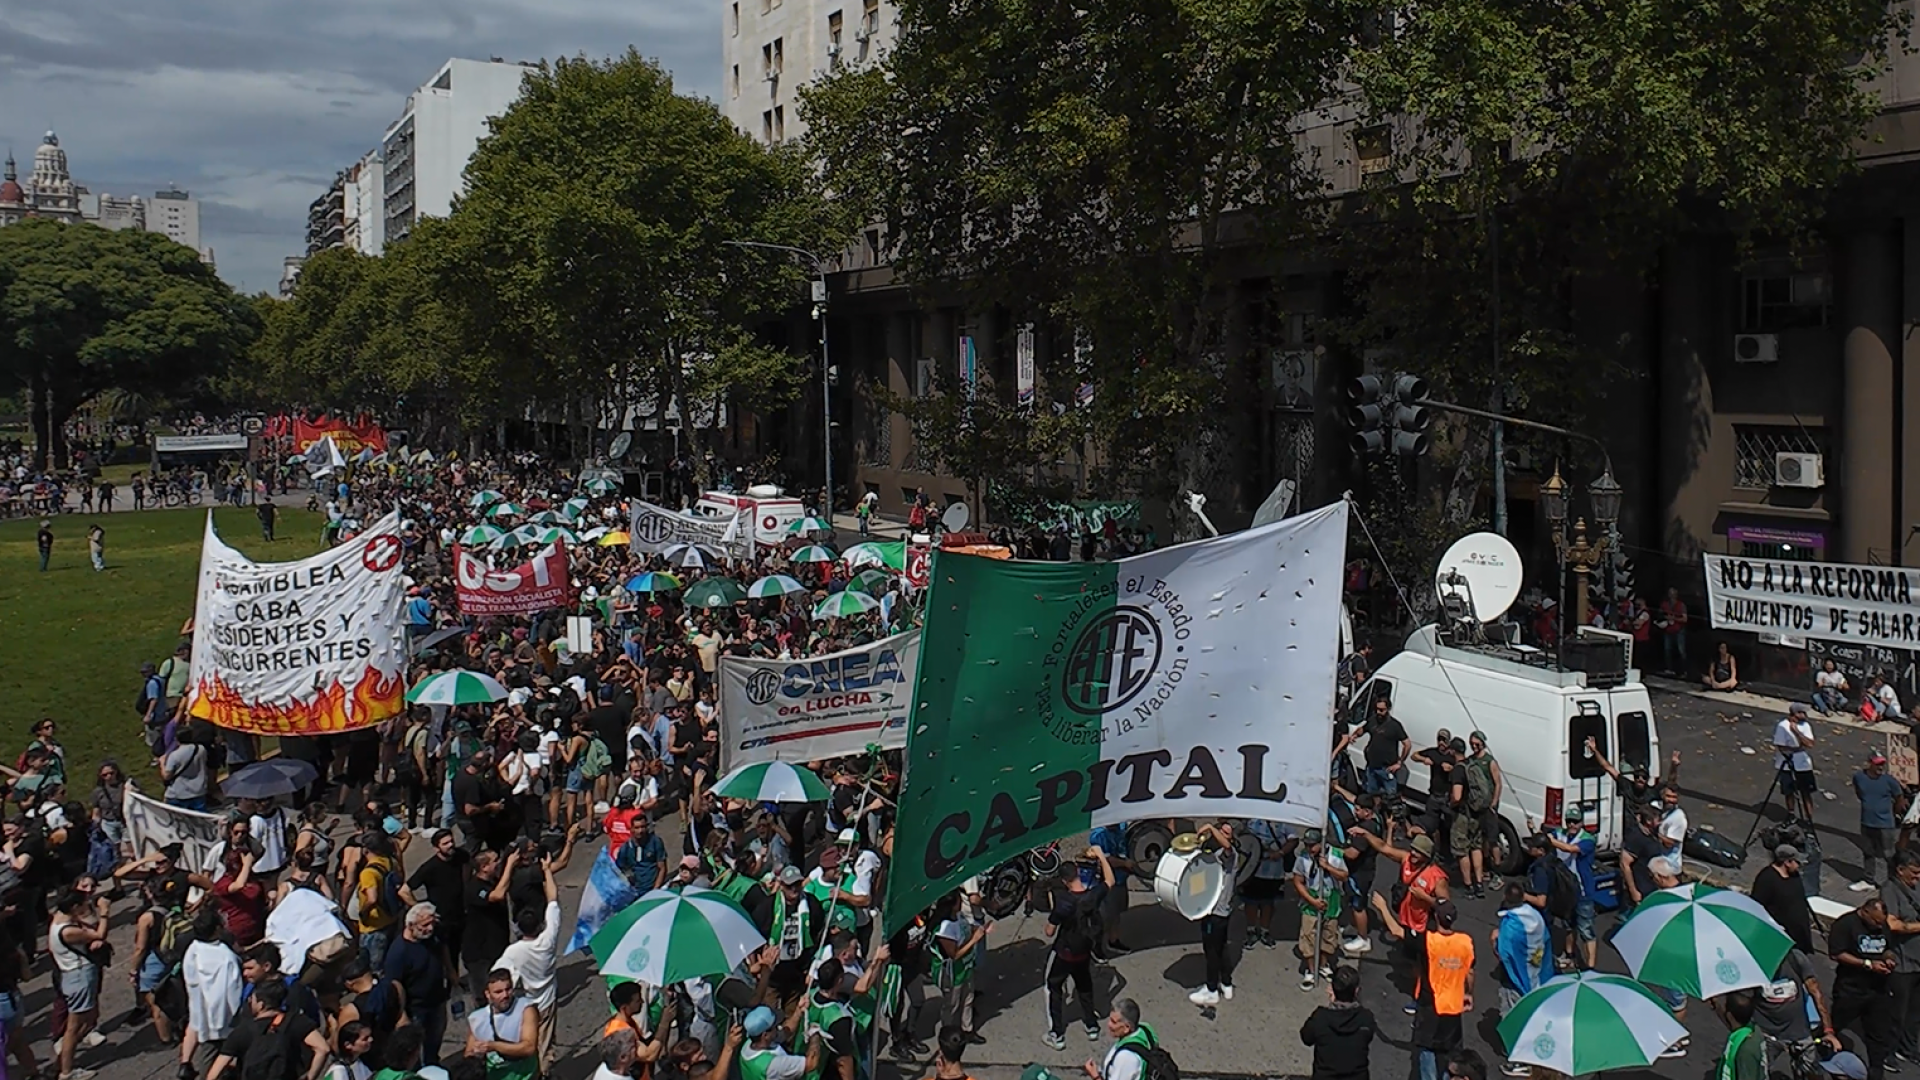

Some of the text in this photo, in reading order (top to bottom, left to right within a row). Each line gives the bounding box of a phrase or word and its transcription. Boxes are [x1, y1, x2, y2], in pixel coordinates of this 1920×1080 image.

[639, 513, 670, 541] ATE
[1720, 558, 1911, 604] NO A LA REFORMA
[235, 599, 302, 622] CABA
[472, 603, 487, 611] LOS
[489, 599, 557, 612] TRABAJADORES
[1043, 575, 1193, 668] Fortalecer el Estado
[1725, 599, 1813, 631] AUMENTOS
[1829, 608, 1849, 634] DE
[214, 612, 354, 647] ESIDENTES Y
[781, 650, 906, 698] CNEA
[1070, 615, 1150, 703] ATE
[778, 692, 872, 716] en LUCHA
[1052, 717, 1109, 745] liberar
[1115, 718, 1134, 736] la
[1133, 657, 1189, 723] Nación
[1890, 733, 1910, 747] NO
[924, 745, 1287, 880] CAPITAL
